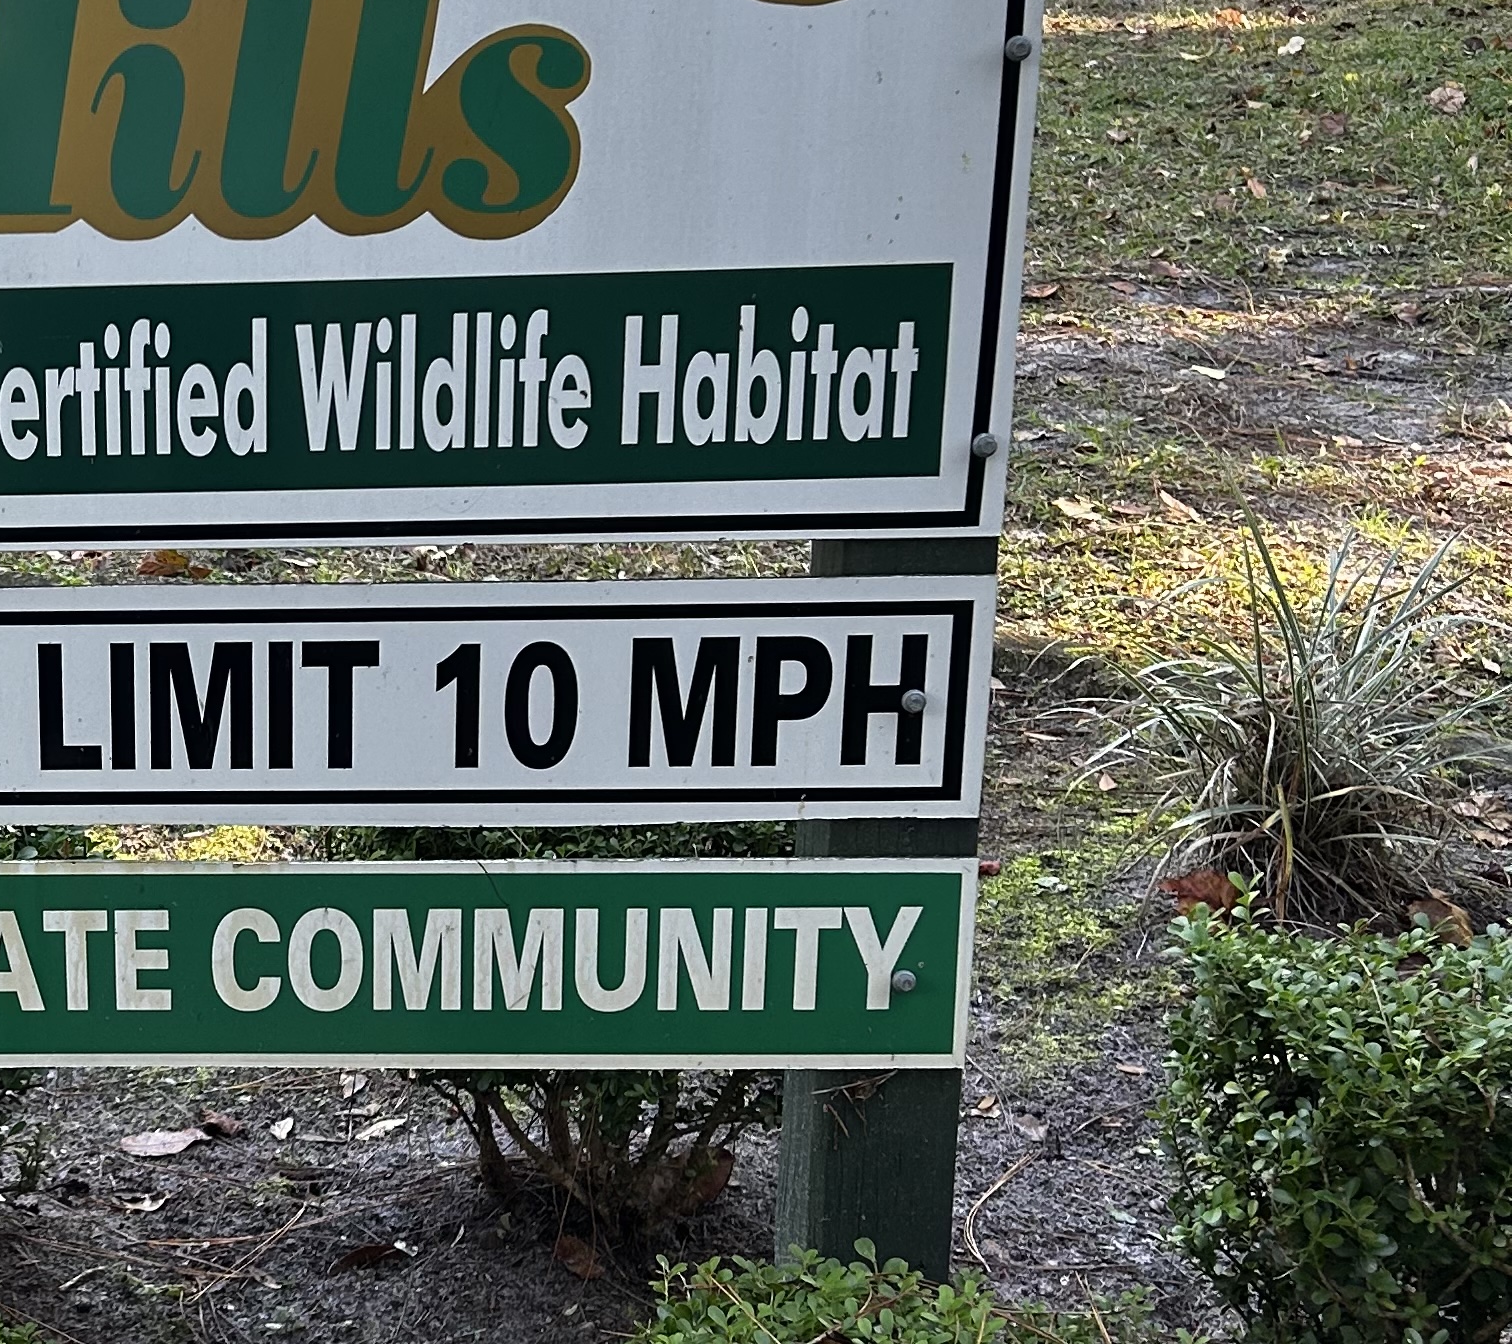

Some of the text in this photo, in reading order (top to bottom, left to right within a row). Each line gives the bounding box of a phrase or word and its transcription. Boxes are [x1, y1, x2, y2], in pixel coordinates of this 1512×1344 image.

[295, 308, 591, 452] Wildlife
[620, 305, 919, 446] Habitat
[37, 640, 380, 771] LIMIT
[435, 640, 579, 770] 10
[627, 633, 929, 767] MPH
[211, 905, 924, 1013] COMMUNITY
